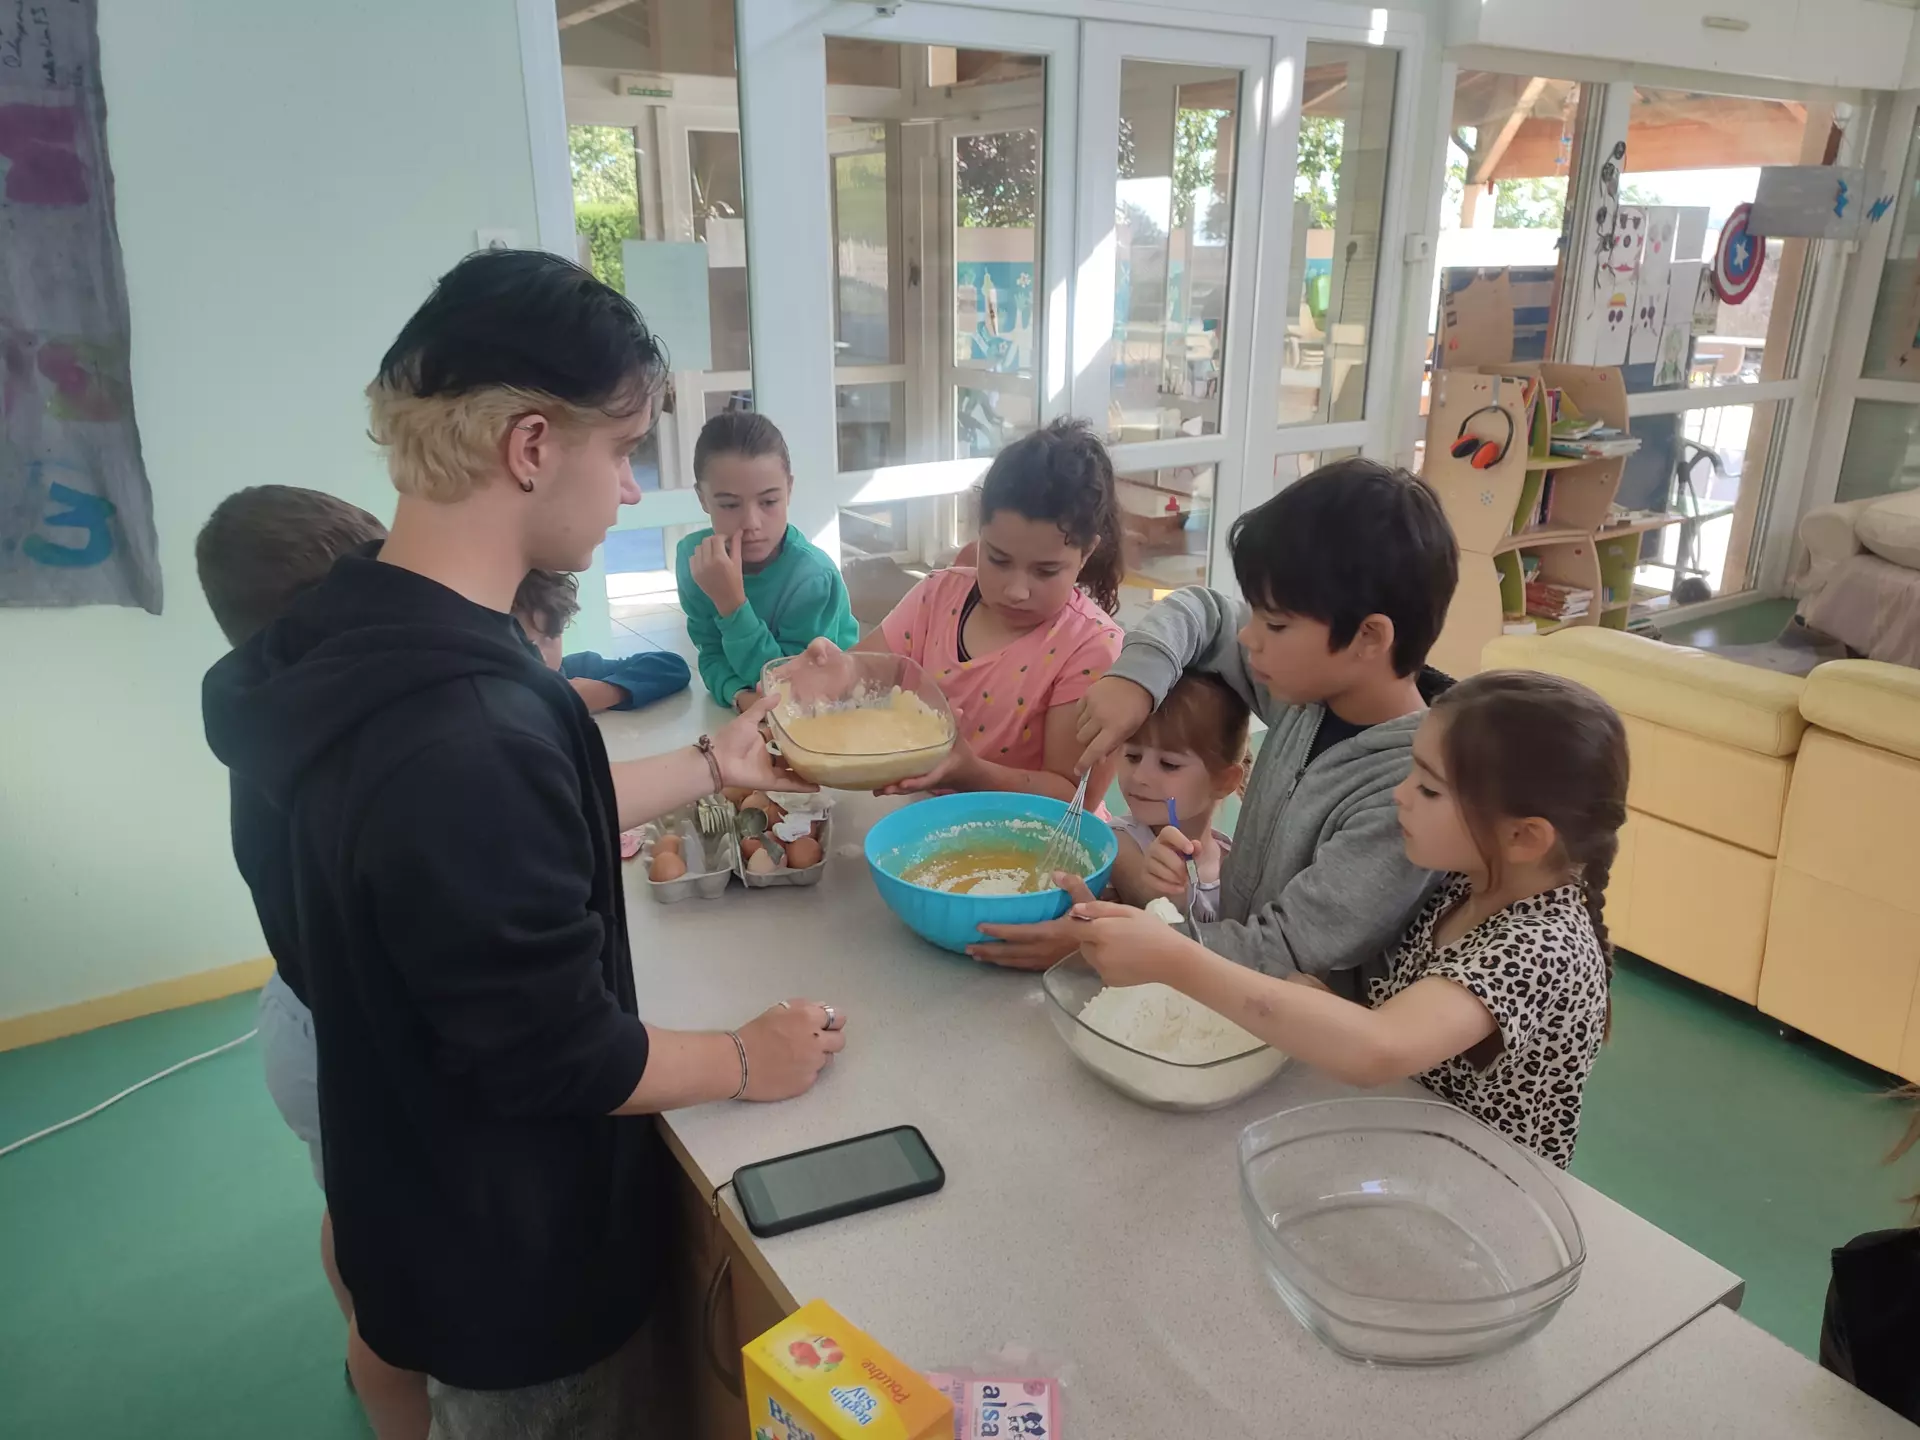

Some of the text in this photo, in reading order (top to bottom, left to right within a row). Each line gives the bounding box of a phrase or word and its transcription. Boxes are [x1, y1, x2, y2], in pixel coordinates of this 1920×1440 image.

[846, 1386, 878, 1412] Say
[861, 1357, 910, 1405] Poudre
[981, 1385, 1007, 1438] alsa
